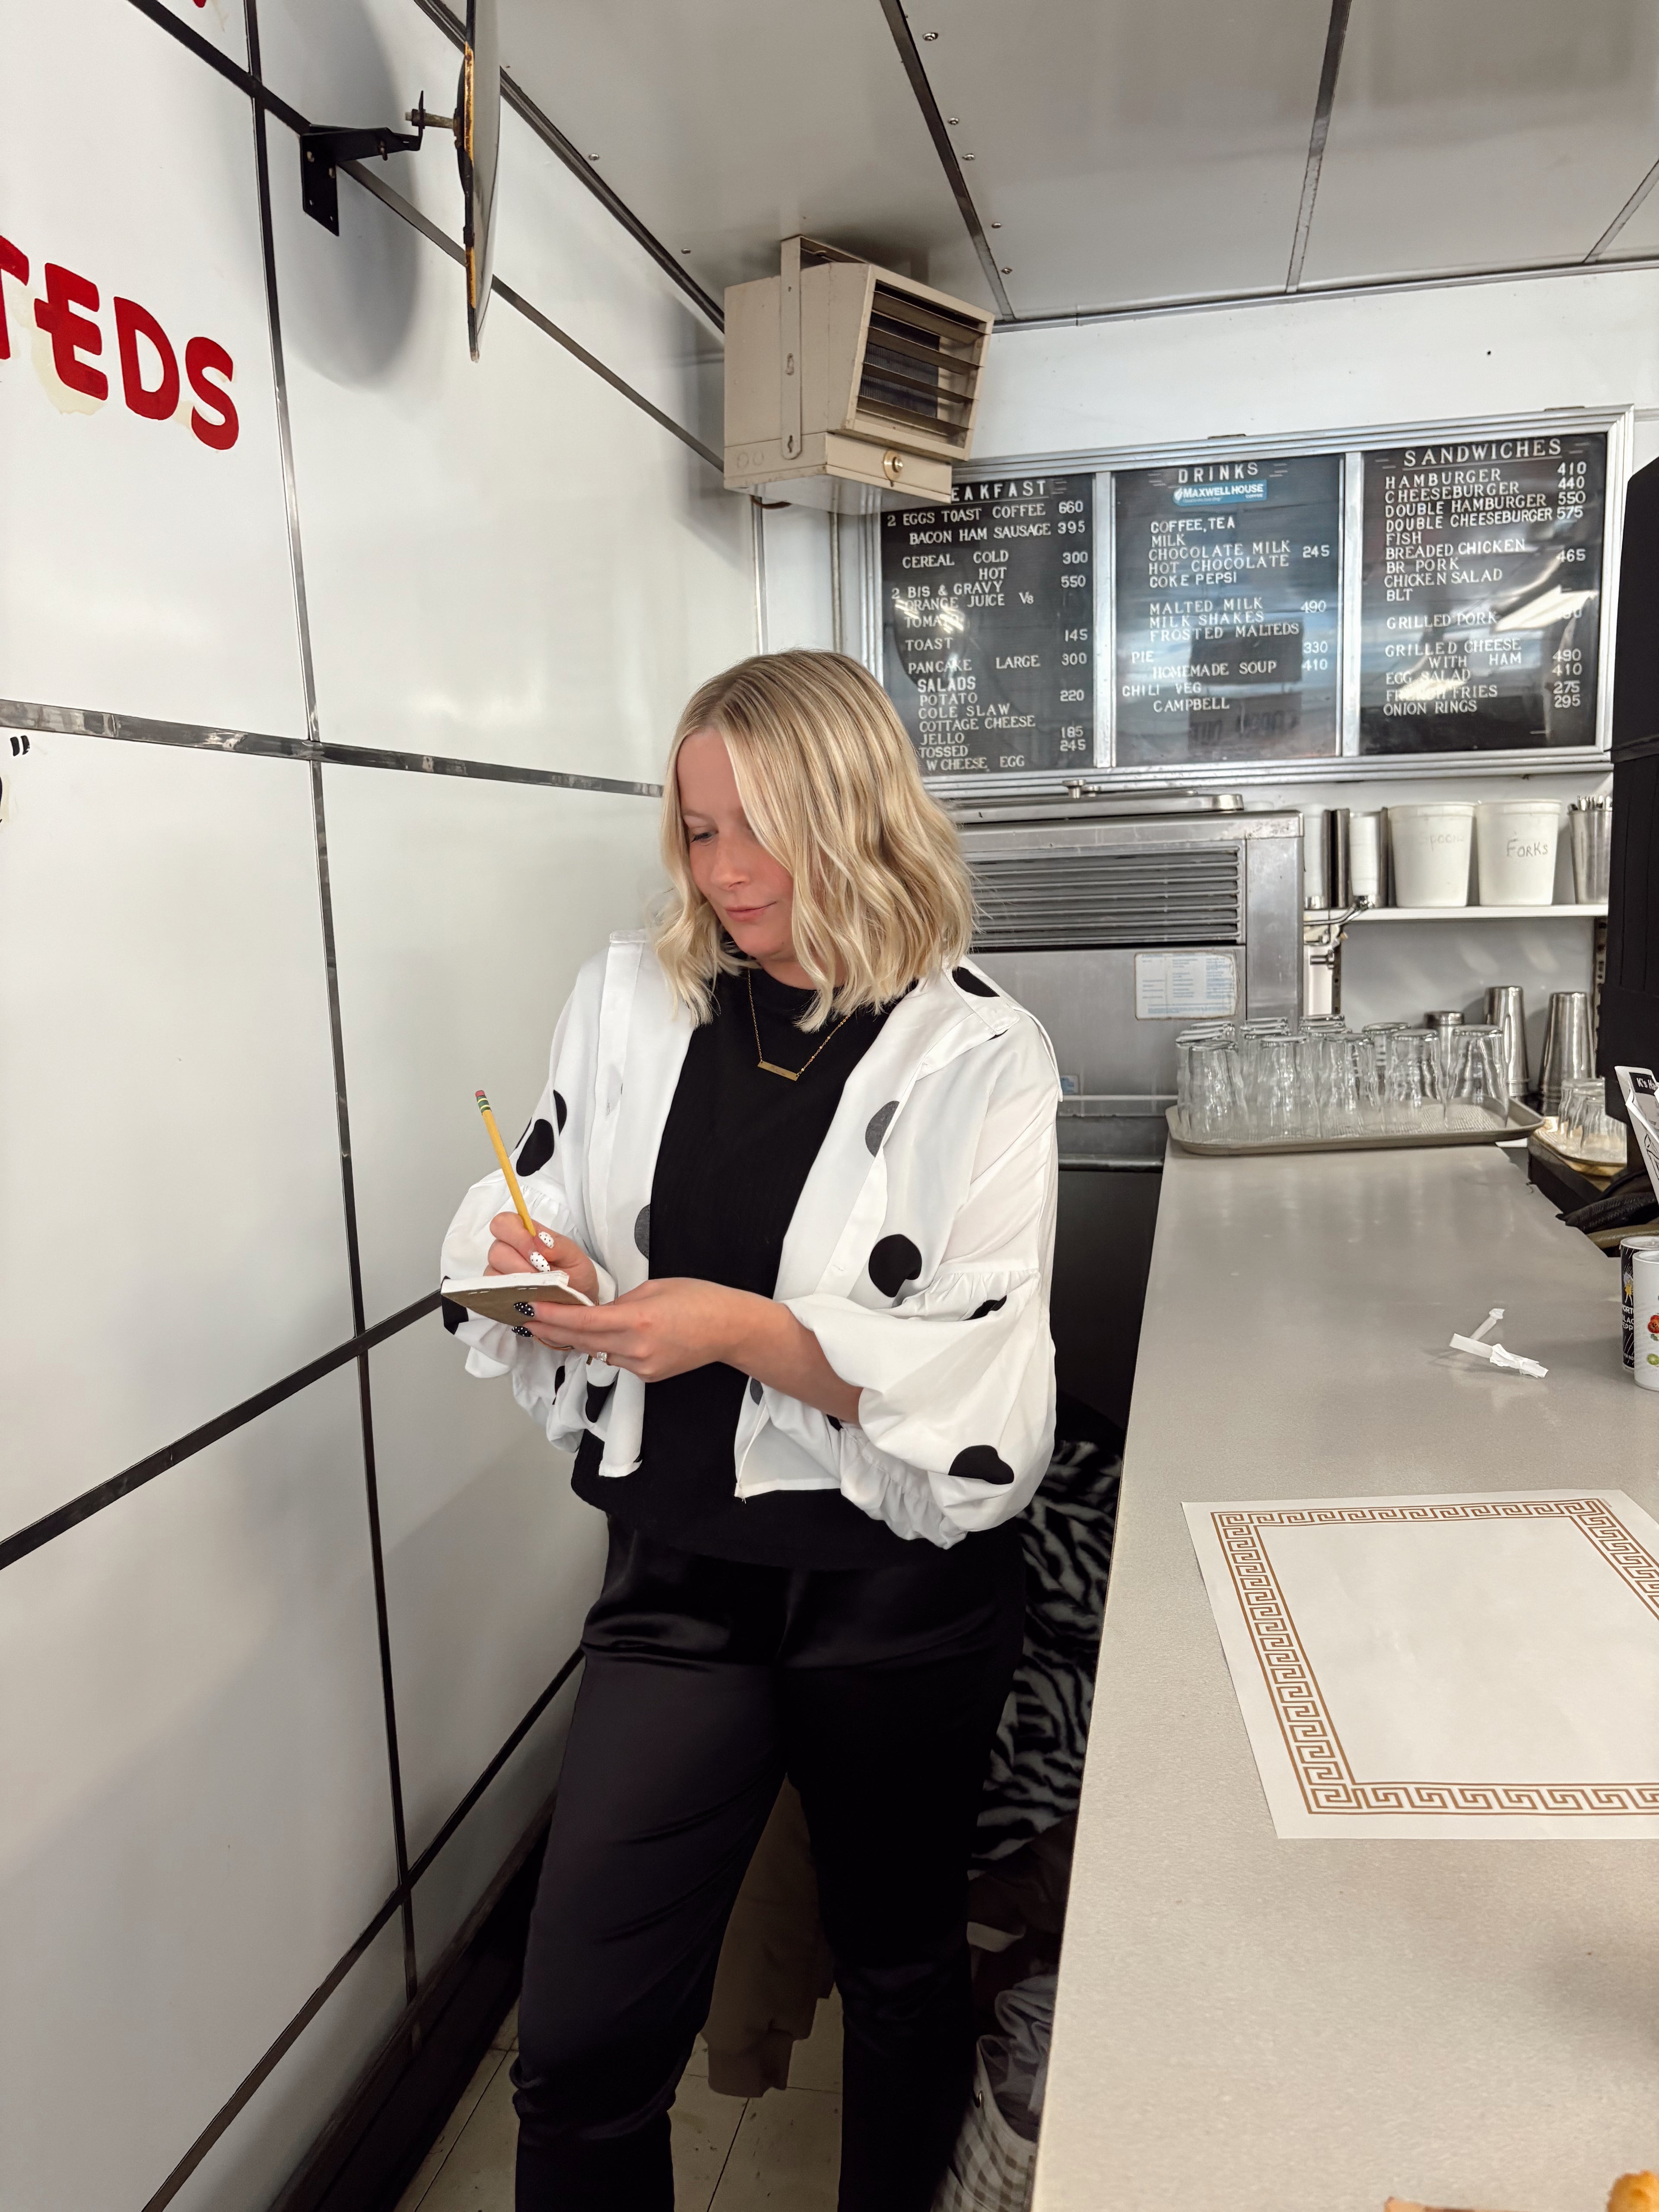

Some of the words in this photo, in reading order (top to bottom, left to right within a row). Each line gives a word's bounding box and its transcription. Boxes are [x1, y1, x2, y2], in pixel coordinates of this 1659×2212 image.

[1404, 439, 1561, 467] SANDWICHES
[1178, 462, 1259, 483] DRINKS
[1386, 468, 1501, 489] HAMBURGER
[1557, 461, 1586, 474] 410
[951, 480, 1046, 502] EAKFAST
[1183, 487, 1230, 498] MAXWELL
[1231, 484, 1263, 495] HOUSE
[1386, 481, 1519, 504] CHEESEBURGER
[1558, 476, 1585, 489] 440
[887, 516, 896, 526] 2
[903, 513, 935, 526] EGGS
[941, 508, 982, 522] TOAST
[993, 504, 1046, 518] COFFEE
[1058, 501, 1084, 514] 660
[1386, 501, 1444, 518] DOUBLE
[1451, 493, 1546, 513] HAMBURGER
[1558, 491, 1586, 505] 550
[1386, 515, 1443, 532] DOUBLE
[1450, 508, 1552, 528] CHEESEBURGER
[1557, 506, 1583, 519] 575
[909, 531, 952, 545] BACON
[959, 528, 987, 541] HAM
[994, 524, 1051, 538] SAUSAGE
[1058, 521, 1085, 534] 395
[1152, 534, 1185, 547] MILK
[1386, 532, 1422, 545] FISH
[1148, 543, 1244, 562] CHOCOLATE
[1252, 540, 1291, 554] MILK
[1303, 545, 1330, 558] 245
[1386, 543, 1453, 560] BREADED
[1458, 538, 1525, 555] CHICKEN
[902, 553, 954, 569] CEREAL
[973, 550, 1009, 563] COLD
[1062, 552, 1088, 564] 300
[1149, 561, 1179, 575] HOT
[1191, 554, 1290, 572] CHOCOLATE
[1386, 562, 1404, 574] BR
[1416, 557, 1460, 572] PORK
[1557, 549, 1586, 562] 465
[979, 568, 1007, 579] HOT
[1150, 574, 1189, 588] COKE
[1195, 571, 1236, 585] PEPSI
[1384, 572, 1446, 588] CHICKEN
[1451, 568, 1503, 583] SALAD
[891, 588, 900, 599] 2
[938, 584, 949, 596] &
[953, 581, 1003, 594] GRAVY
[1061, 575, 1086, 588] 550
[1386, 589, 1413, 601] BLT
[905, 597, 959, 611] ORANGE
[967, 594, 1004, 607] JUICE
[1150, 601, 1212, 615] MALTED
[1224, 597, 1263, 611] MILK
[1300, 600, 1326, 613] 490
[1150, 613, 1190, 629] MILK
[1199, 611, 1264, 626] SHAKES
[1387, 613, 1451, 629] GRILLED
[1457, 611, 1498, 626] PORK
[905, 638, 953, 651] TOAST
[1065, 629, 1088, 642] 145
[1150, 627, 1224, 642] FROSTED
[1235, 623, 1299, 637] MALTEDS
[1132, 651, 1154, 663] PIE
[1303, 642, 1328, 654] 330
[1386, 642, 1457, 658] GRILLED
[1464, 639, 1521, 653] CHEESE
[908, 659, 972, 674] PANCAKE
[996, 655, 1041, 669] LARGE
[1061, 653, 1087, 666] 300
[1429, 656, 1467, 669] WITH
[1489, 652, 1522, 665] HAM
[1552, 648, 1581, 662] 490
[1153, 663, 1229, 679] HOMEMADE
[1239, 660, 1277, 674] SOUP
[1303, 659, 1327, 671] 410
[1386, 672, 1412, 685] EGG
[1421, 669, 1471, 682] SALAD
[1551, 663, 1582, 677] 410
[917, 676, 976, 693] SALADS
[1122, 684, 1160, 697] CHILI
[1176, 683, 1201, 694] VEG
[1453, 685, 1498, 698] FRIES
[1553, 680, 1580, 694] 275
[920, 693, 978, 706] POTATO
[1060, 690, 1084, 702] 220
[1154, 698, 1230, 712] CAMPBELL
[1383, 702, 1427, 717] ONION
[1435, 700, 1477, 714] RINGS
[1554, 695, 1580, 708] 295
[918, 706, 957, 719] COLE
[966, 703, 1010, 717] SLAW
[919, 718, 979, 733] COTTAGE
[985, 715, 1036, 729] CHEESE
[920, 732, 965, 745] JELLO
[1061, 726, 1084, 738] 185
[918, 745, 968, 758] TOSSED
[1060, 739, 1086, 751] 245
[1000, 756, 1025, 768] EGG
